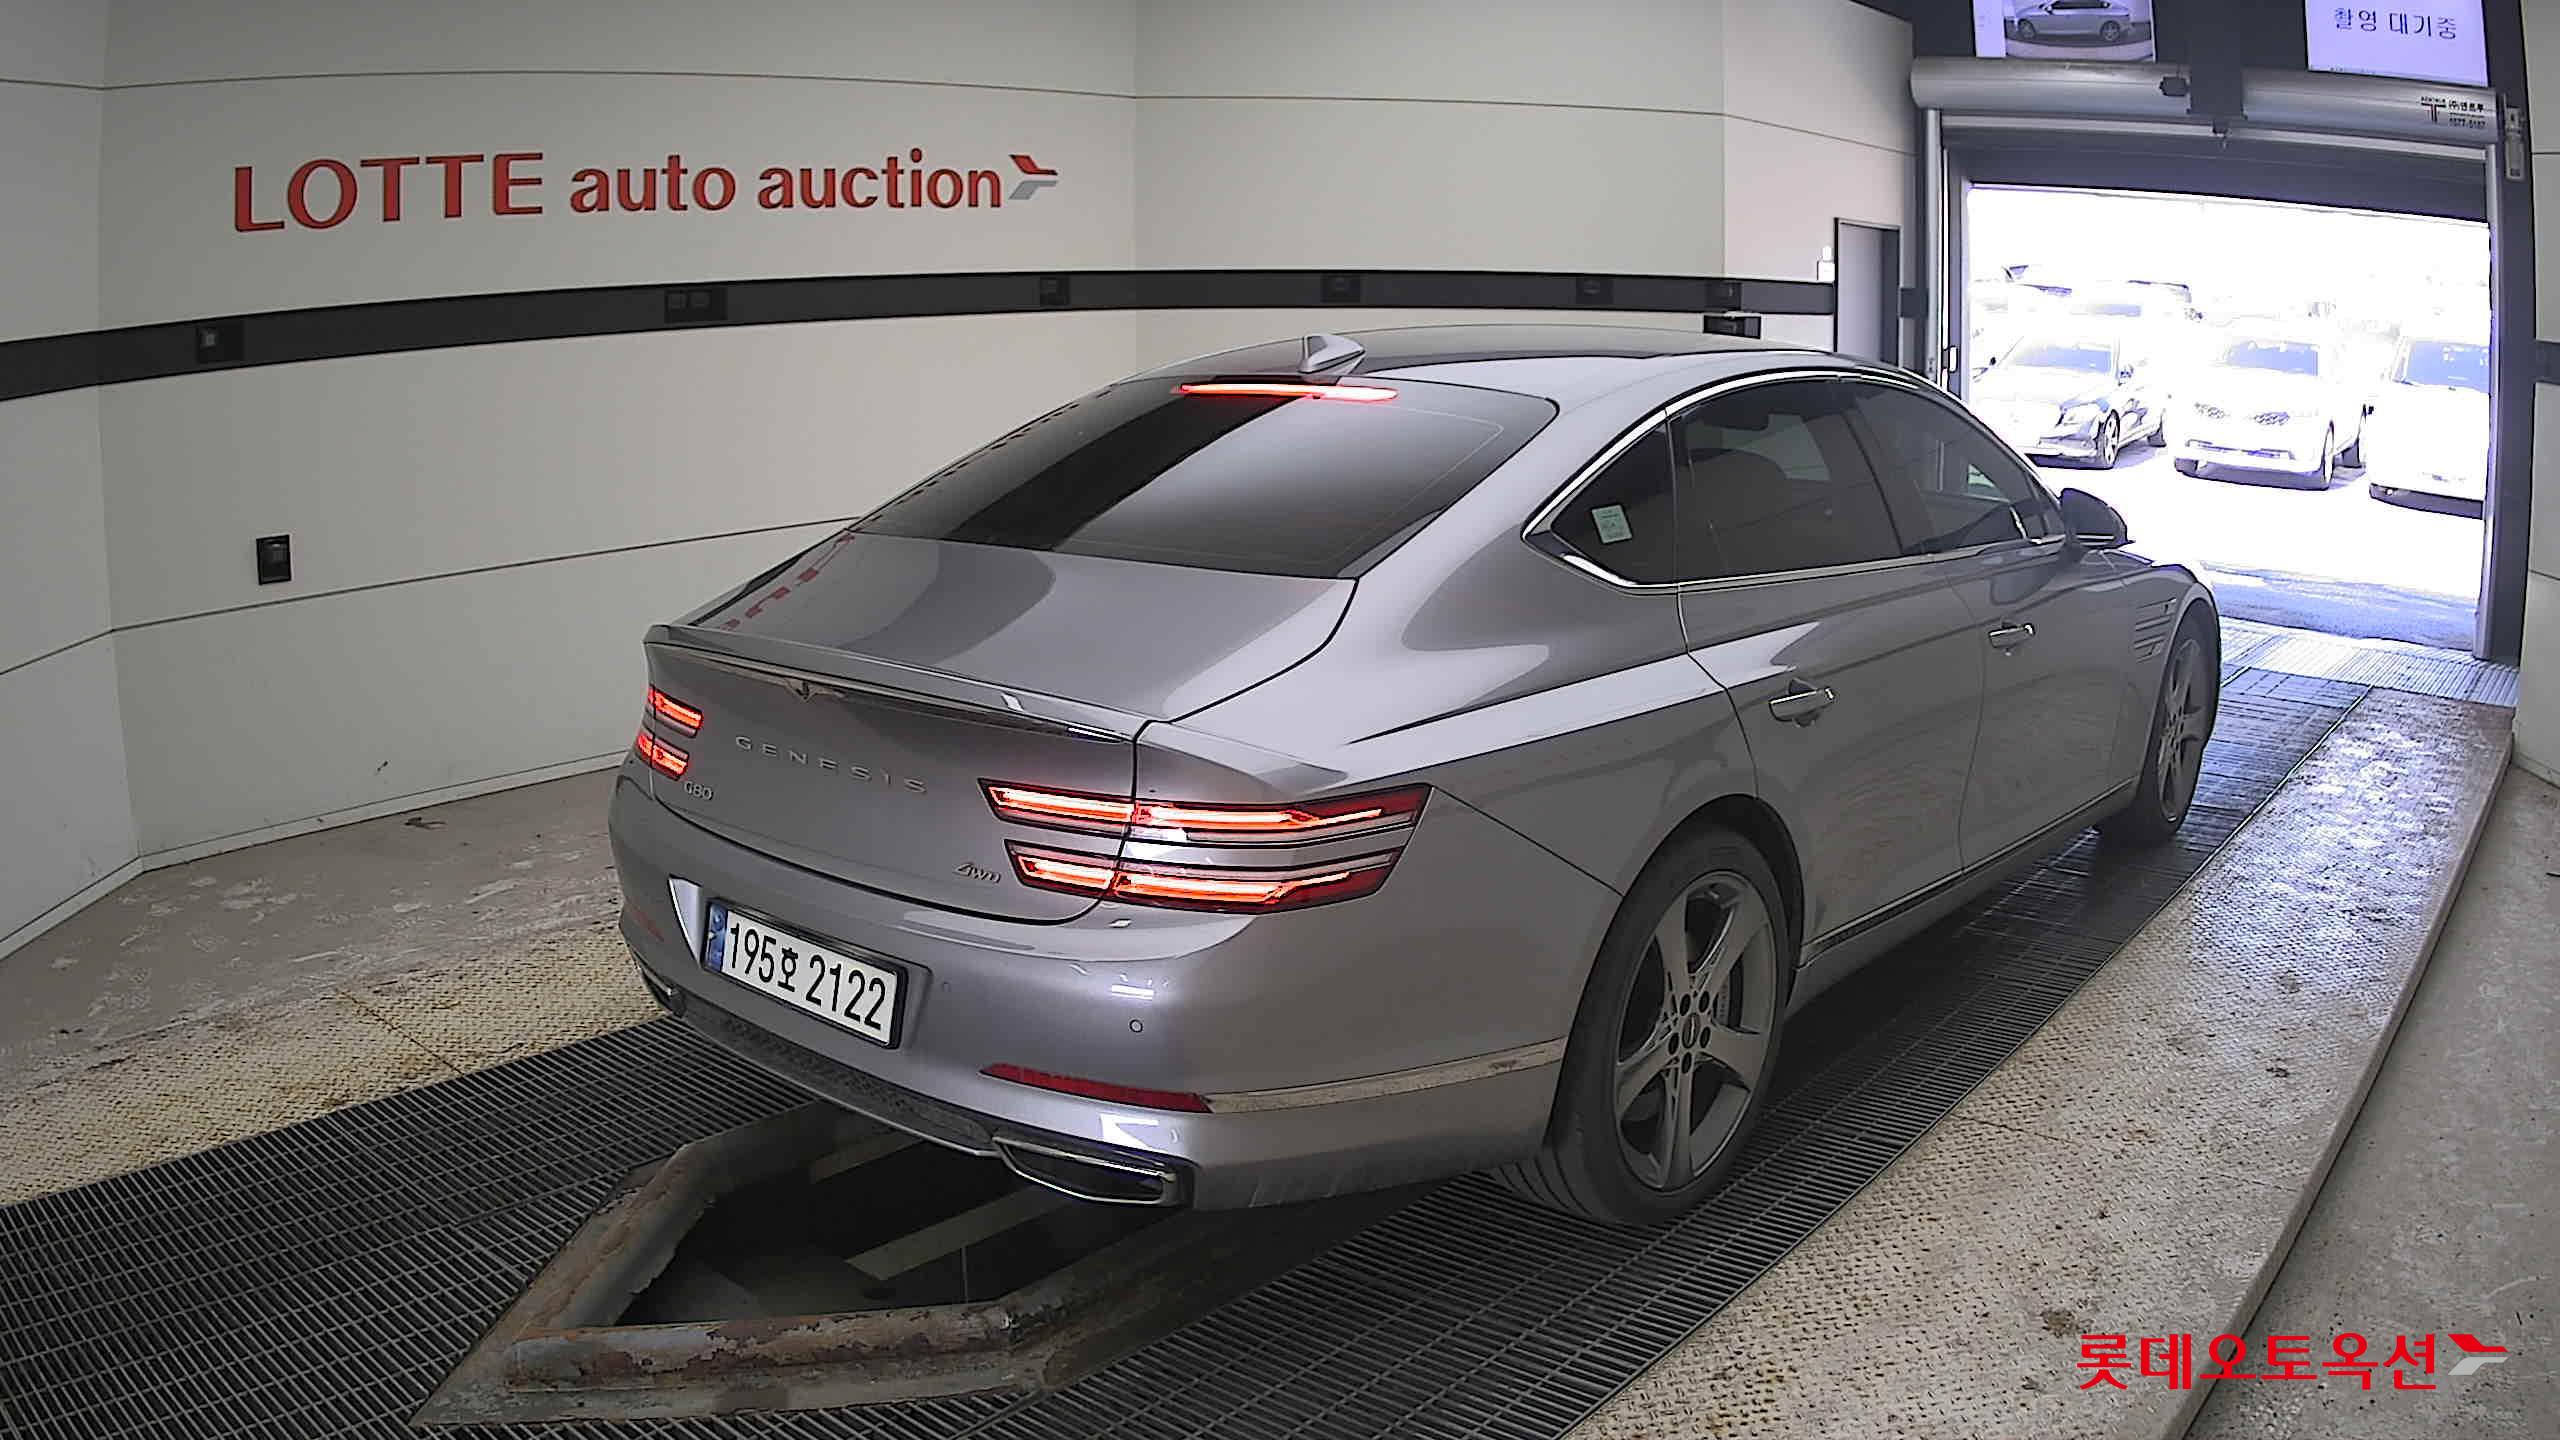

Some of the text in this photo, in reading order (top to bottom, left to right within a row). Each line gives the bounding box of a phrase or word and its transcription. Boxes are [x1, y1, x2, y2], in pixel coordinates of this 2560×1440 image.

[2334, 8, 2457, 40] 촬영 대기중
[234, 147, 1003, 232] LOTTE auto auction
[684, 780, 714, 801] G80
[735, 735, 927, 794] GENESIS
[729, 922, 886, 1031] 195호 2122
